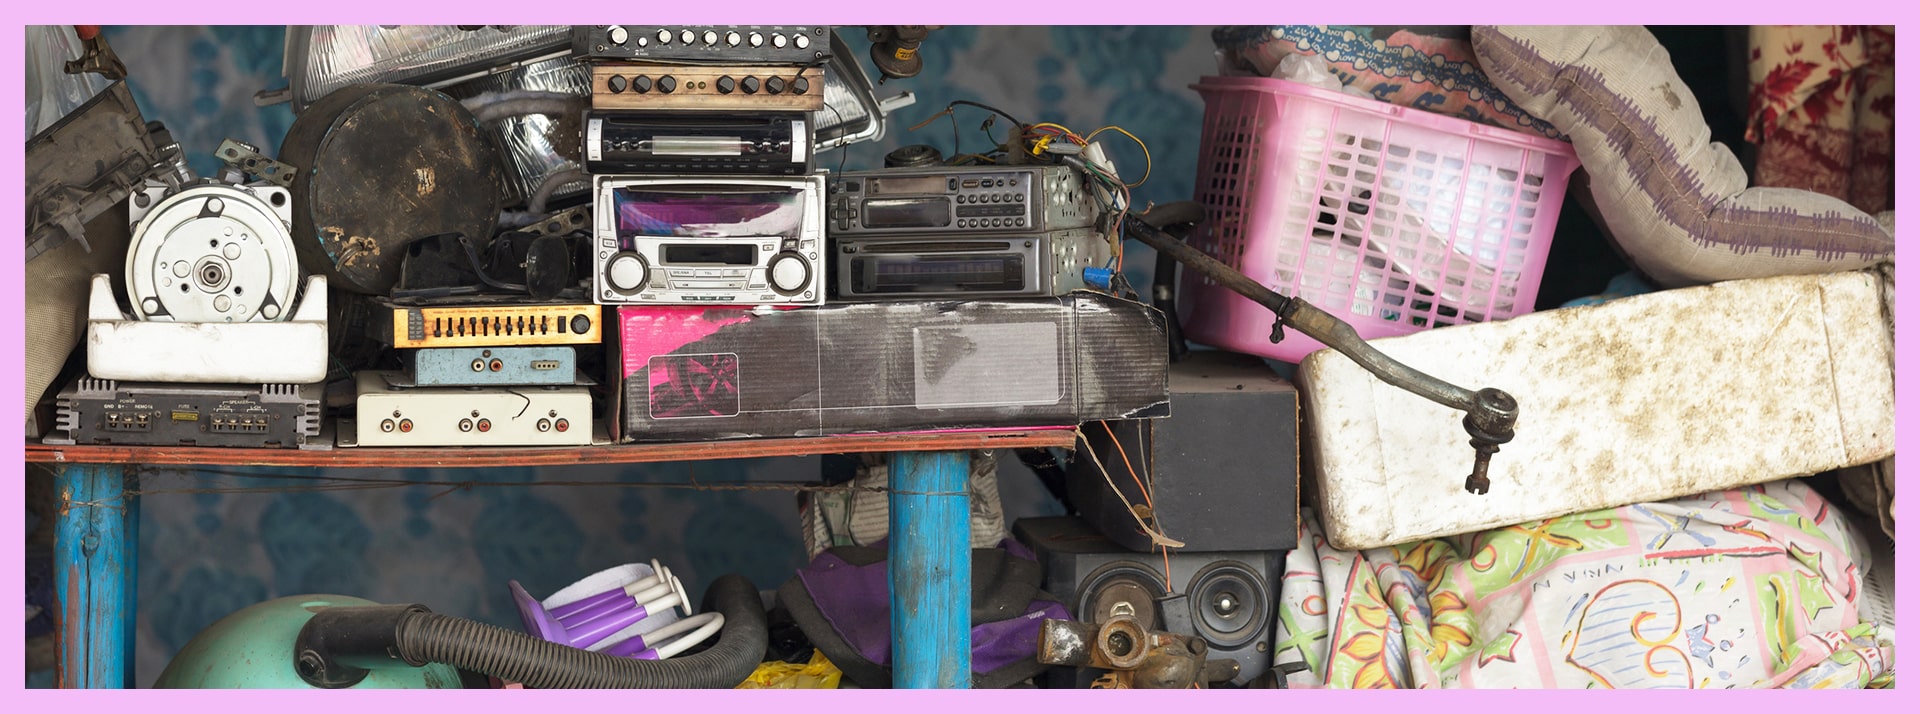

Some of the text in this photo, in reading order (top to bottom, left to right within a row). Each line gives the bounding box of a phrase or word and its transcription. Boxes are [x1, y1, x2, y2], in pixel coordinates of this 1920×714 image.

[1283, 34, 1301, 42] LOVE
[1338, 54, 1357, 62] LOVE
[1368, 60, 1383, 74] LOVE
